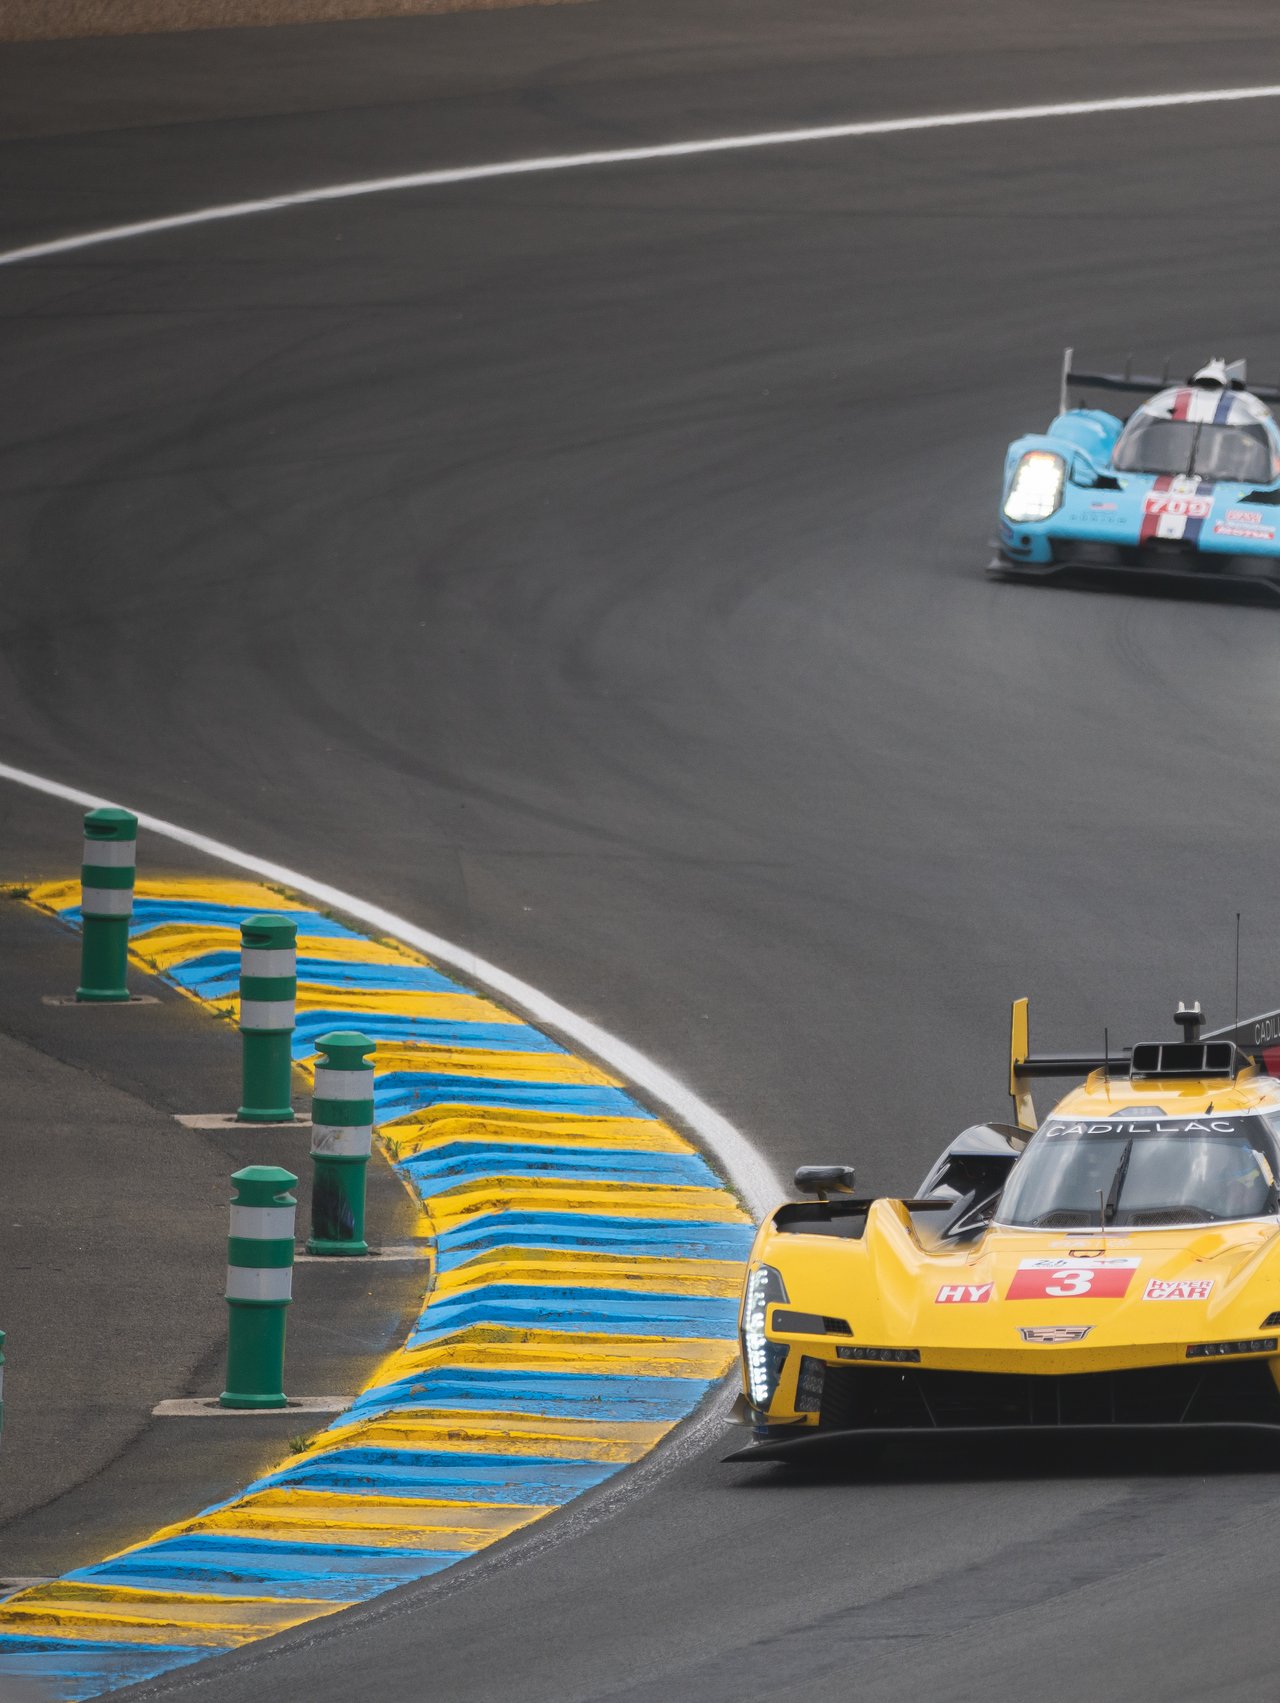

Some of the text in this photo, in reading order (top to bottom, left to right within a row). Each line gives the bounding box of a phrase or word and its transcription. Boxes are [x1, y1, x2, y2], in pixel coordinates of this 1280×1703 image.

[1046, 1121, 1235, 1138] CADILLAC
[1045, 1269, 1095, 1297] 3
[1151, 1280, 1211, 1289] HYPER
[937, 1284, 993, 1302] HY
[1147, 1287, 1207, 1299] CAR
